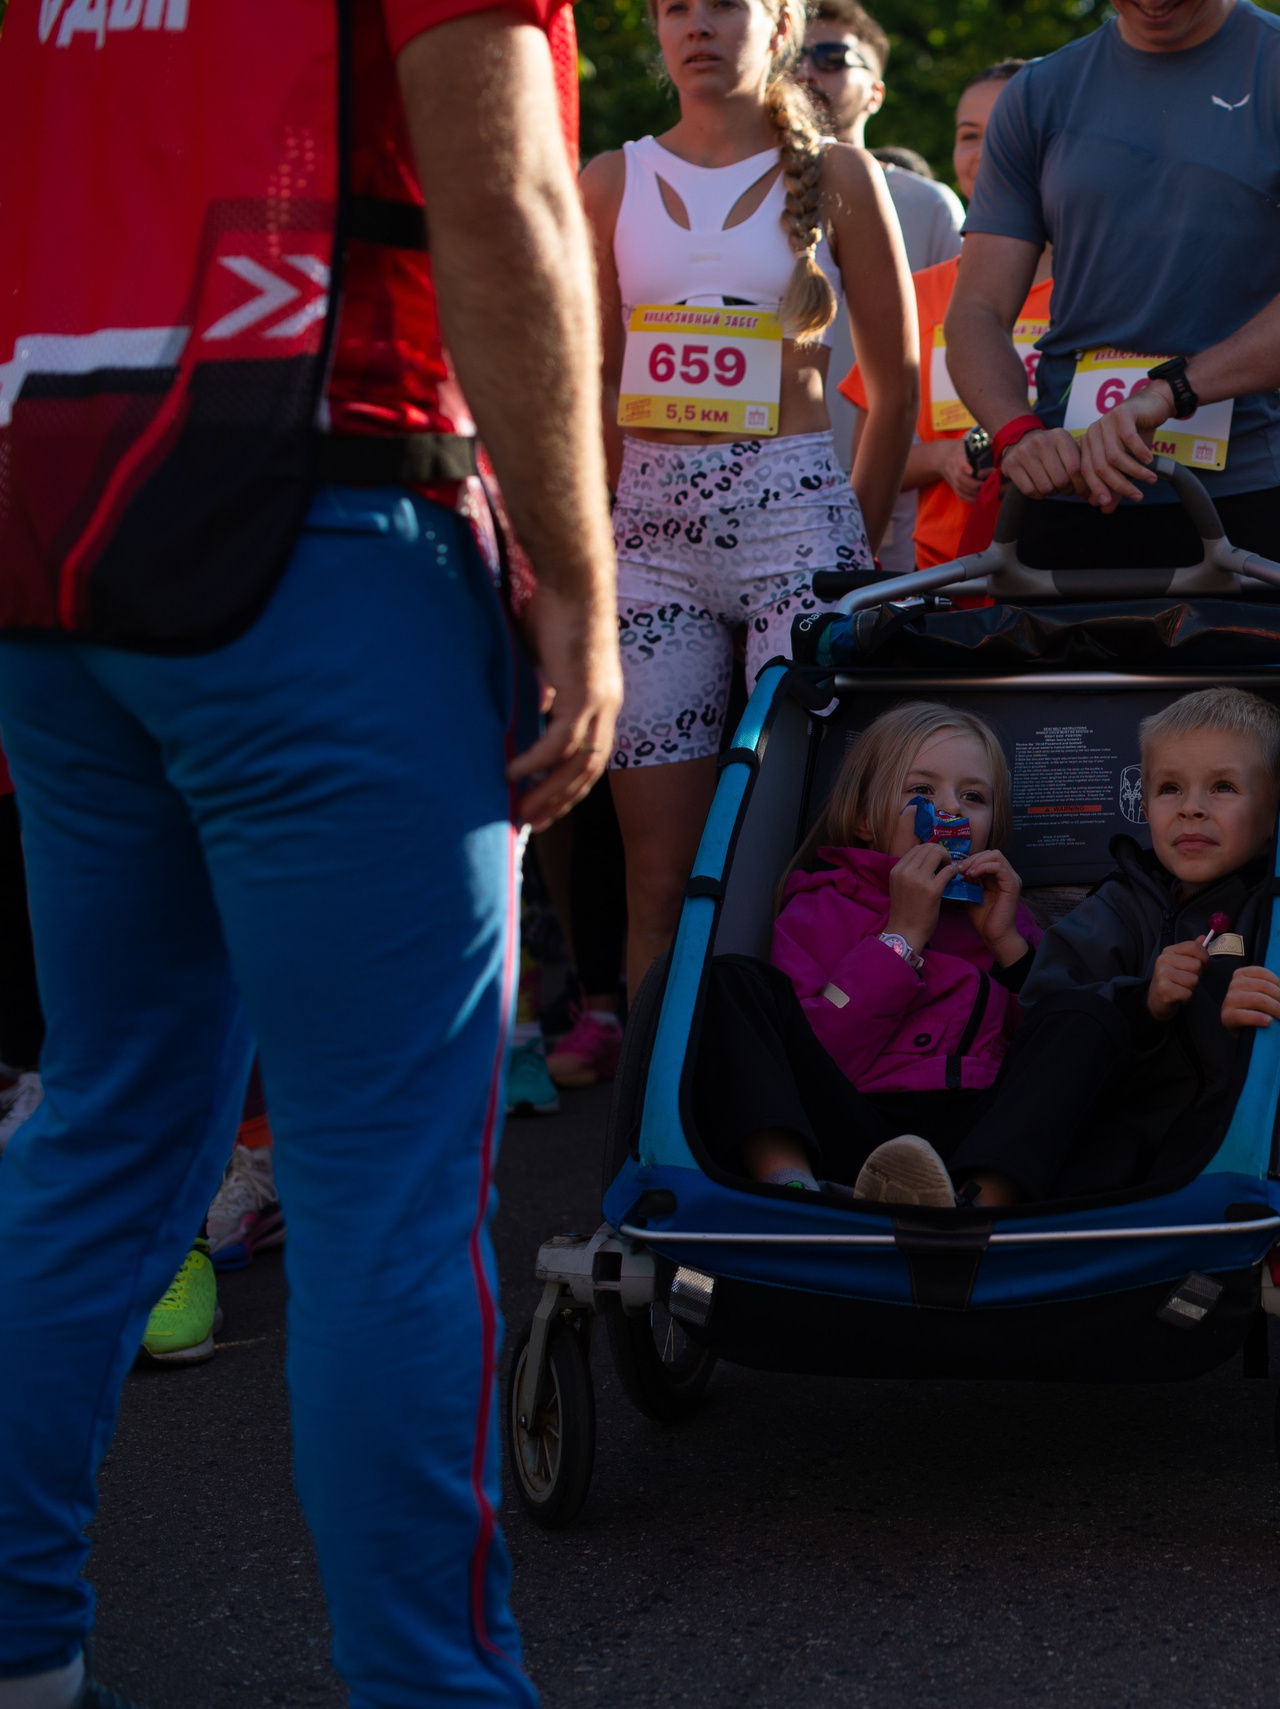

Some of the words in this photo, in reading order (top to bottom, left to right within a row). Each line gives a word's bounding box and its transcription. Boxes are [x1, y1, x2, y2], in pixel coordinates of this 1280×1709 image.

[723, 315, 760, 330] ЗАБЕГ
[648, 343, 747, 386] 659
[666, 403, 696, 423] 5,5
